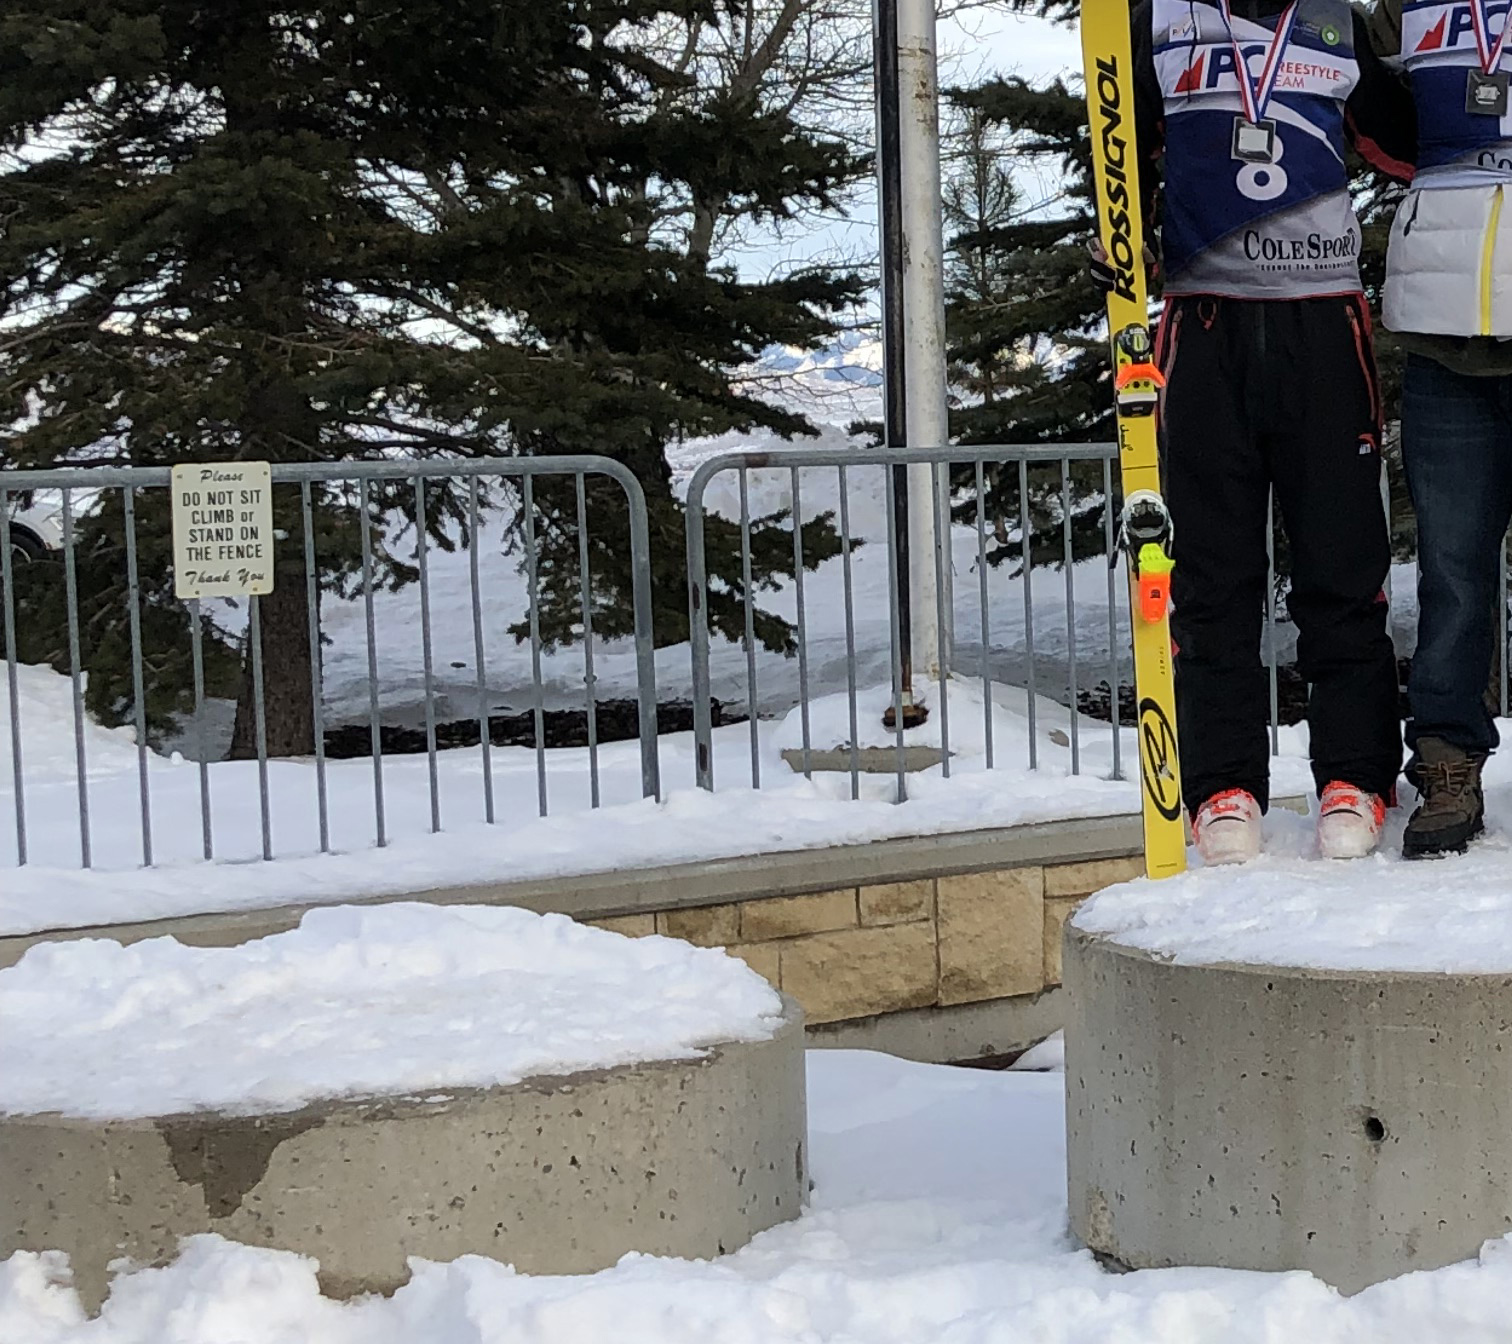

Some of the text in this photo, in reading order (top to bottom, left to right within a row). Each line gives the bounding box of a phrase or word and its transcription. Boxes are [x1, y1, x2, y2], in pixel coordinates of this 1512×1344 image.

[1279, 61, 1341, 81] REESTYLE
[1274, 74, 1305, 89] EAM
[1236, 132, 1288, 201] 8
[1096, 54, 1137, 304] ROSSIGNOL
[200, 469, 244, 483] Please
[182, 489, 262, 507] DO NOT SIT
[191, 509, 254, 525] CLIMB or
[189, 526, 259, 543] STAND ON
[186, 544, 263, 561] THE FENCE
[185, 568, 264, 587] Thank You
